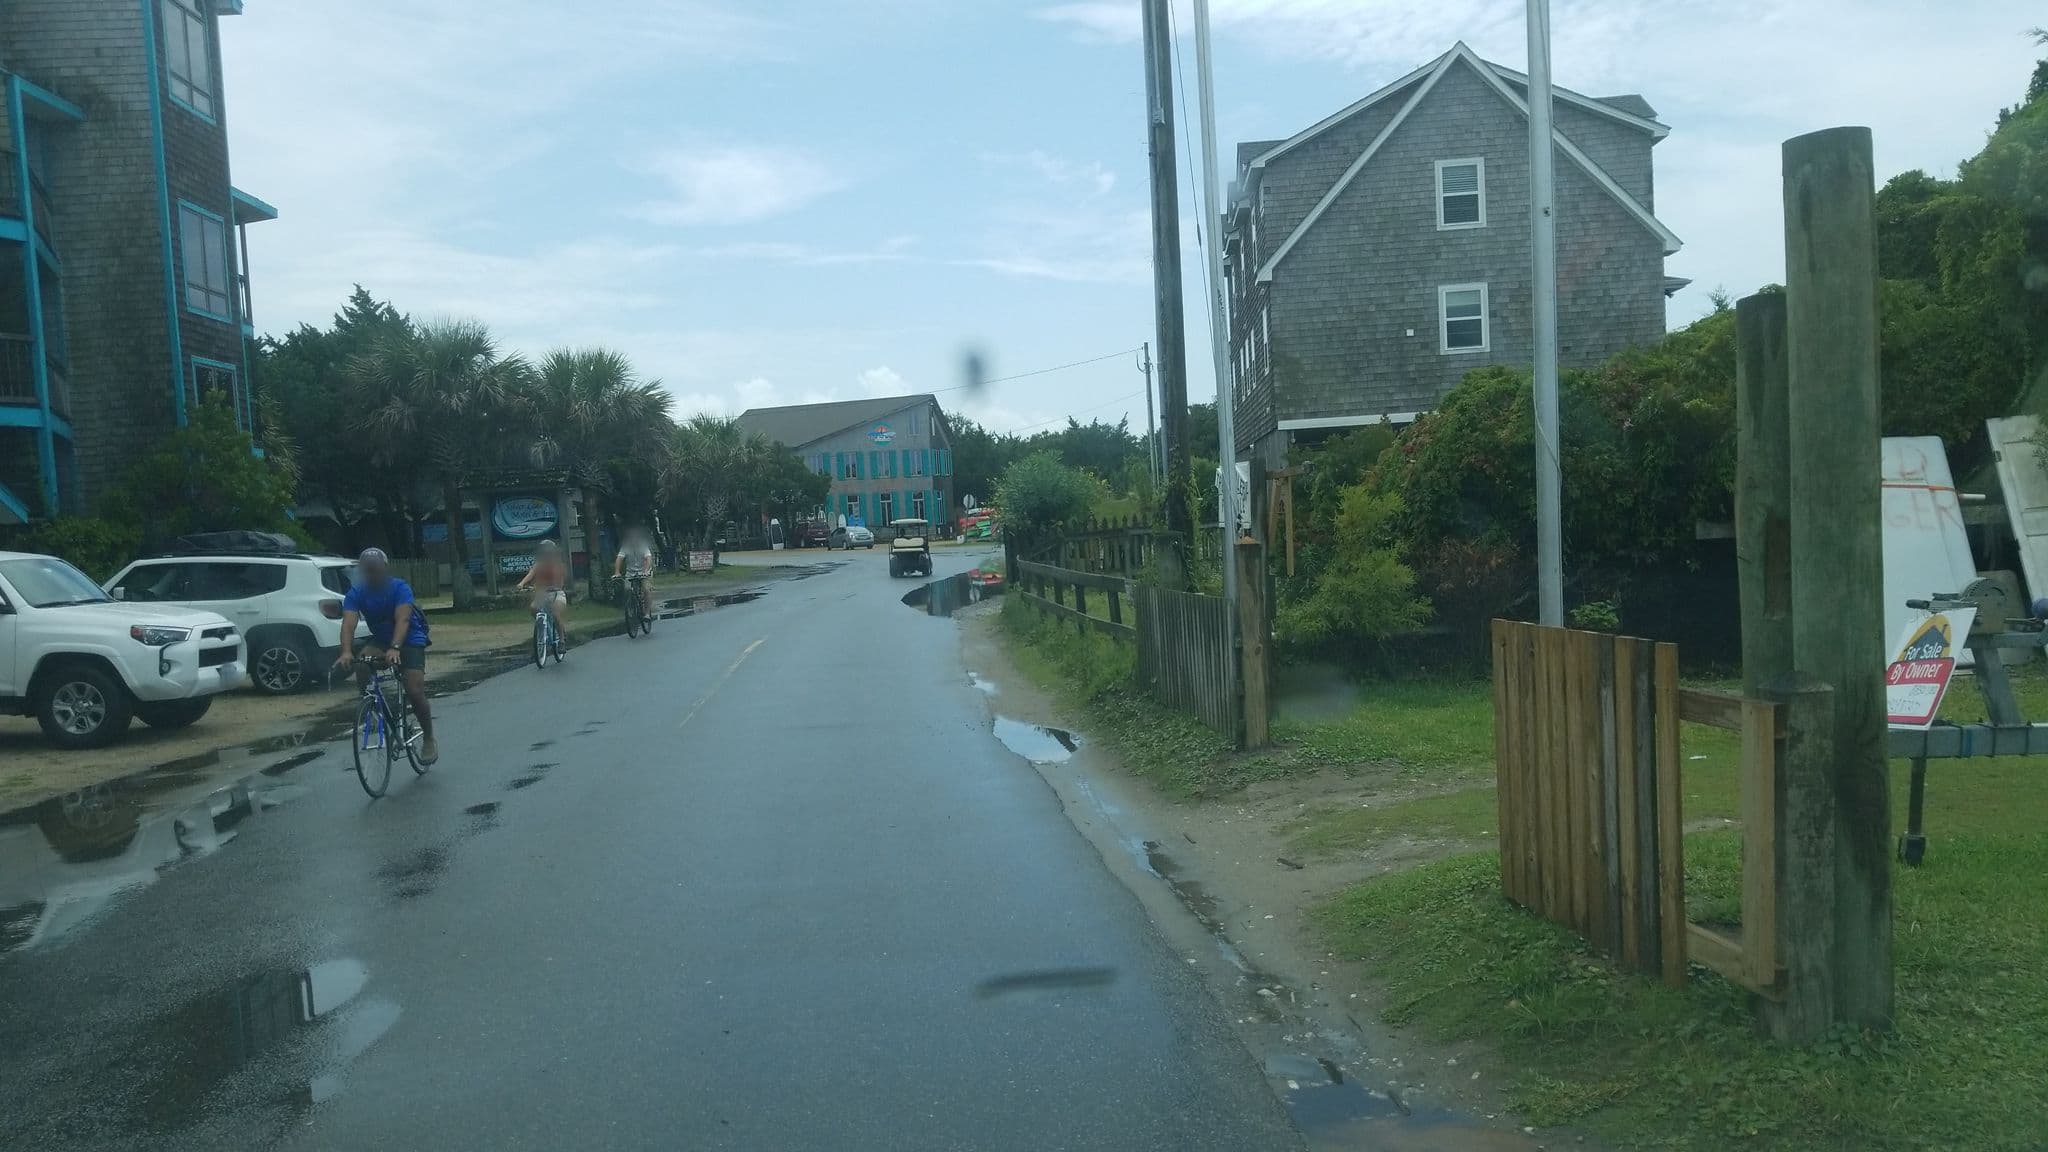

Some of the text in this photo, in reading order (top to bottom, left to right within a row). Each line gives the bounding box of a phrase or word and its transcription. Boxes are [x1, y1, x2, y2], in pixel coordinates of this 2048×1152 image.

[1904, 642, 1942, 660] For Sale
[1890, 662, 1942, 684] By Owner
